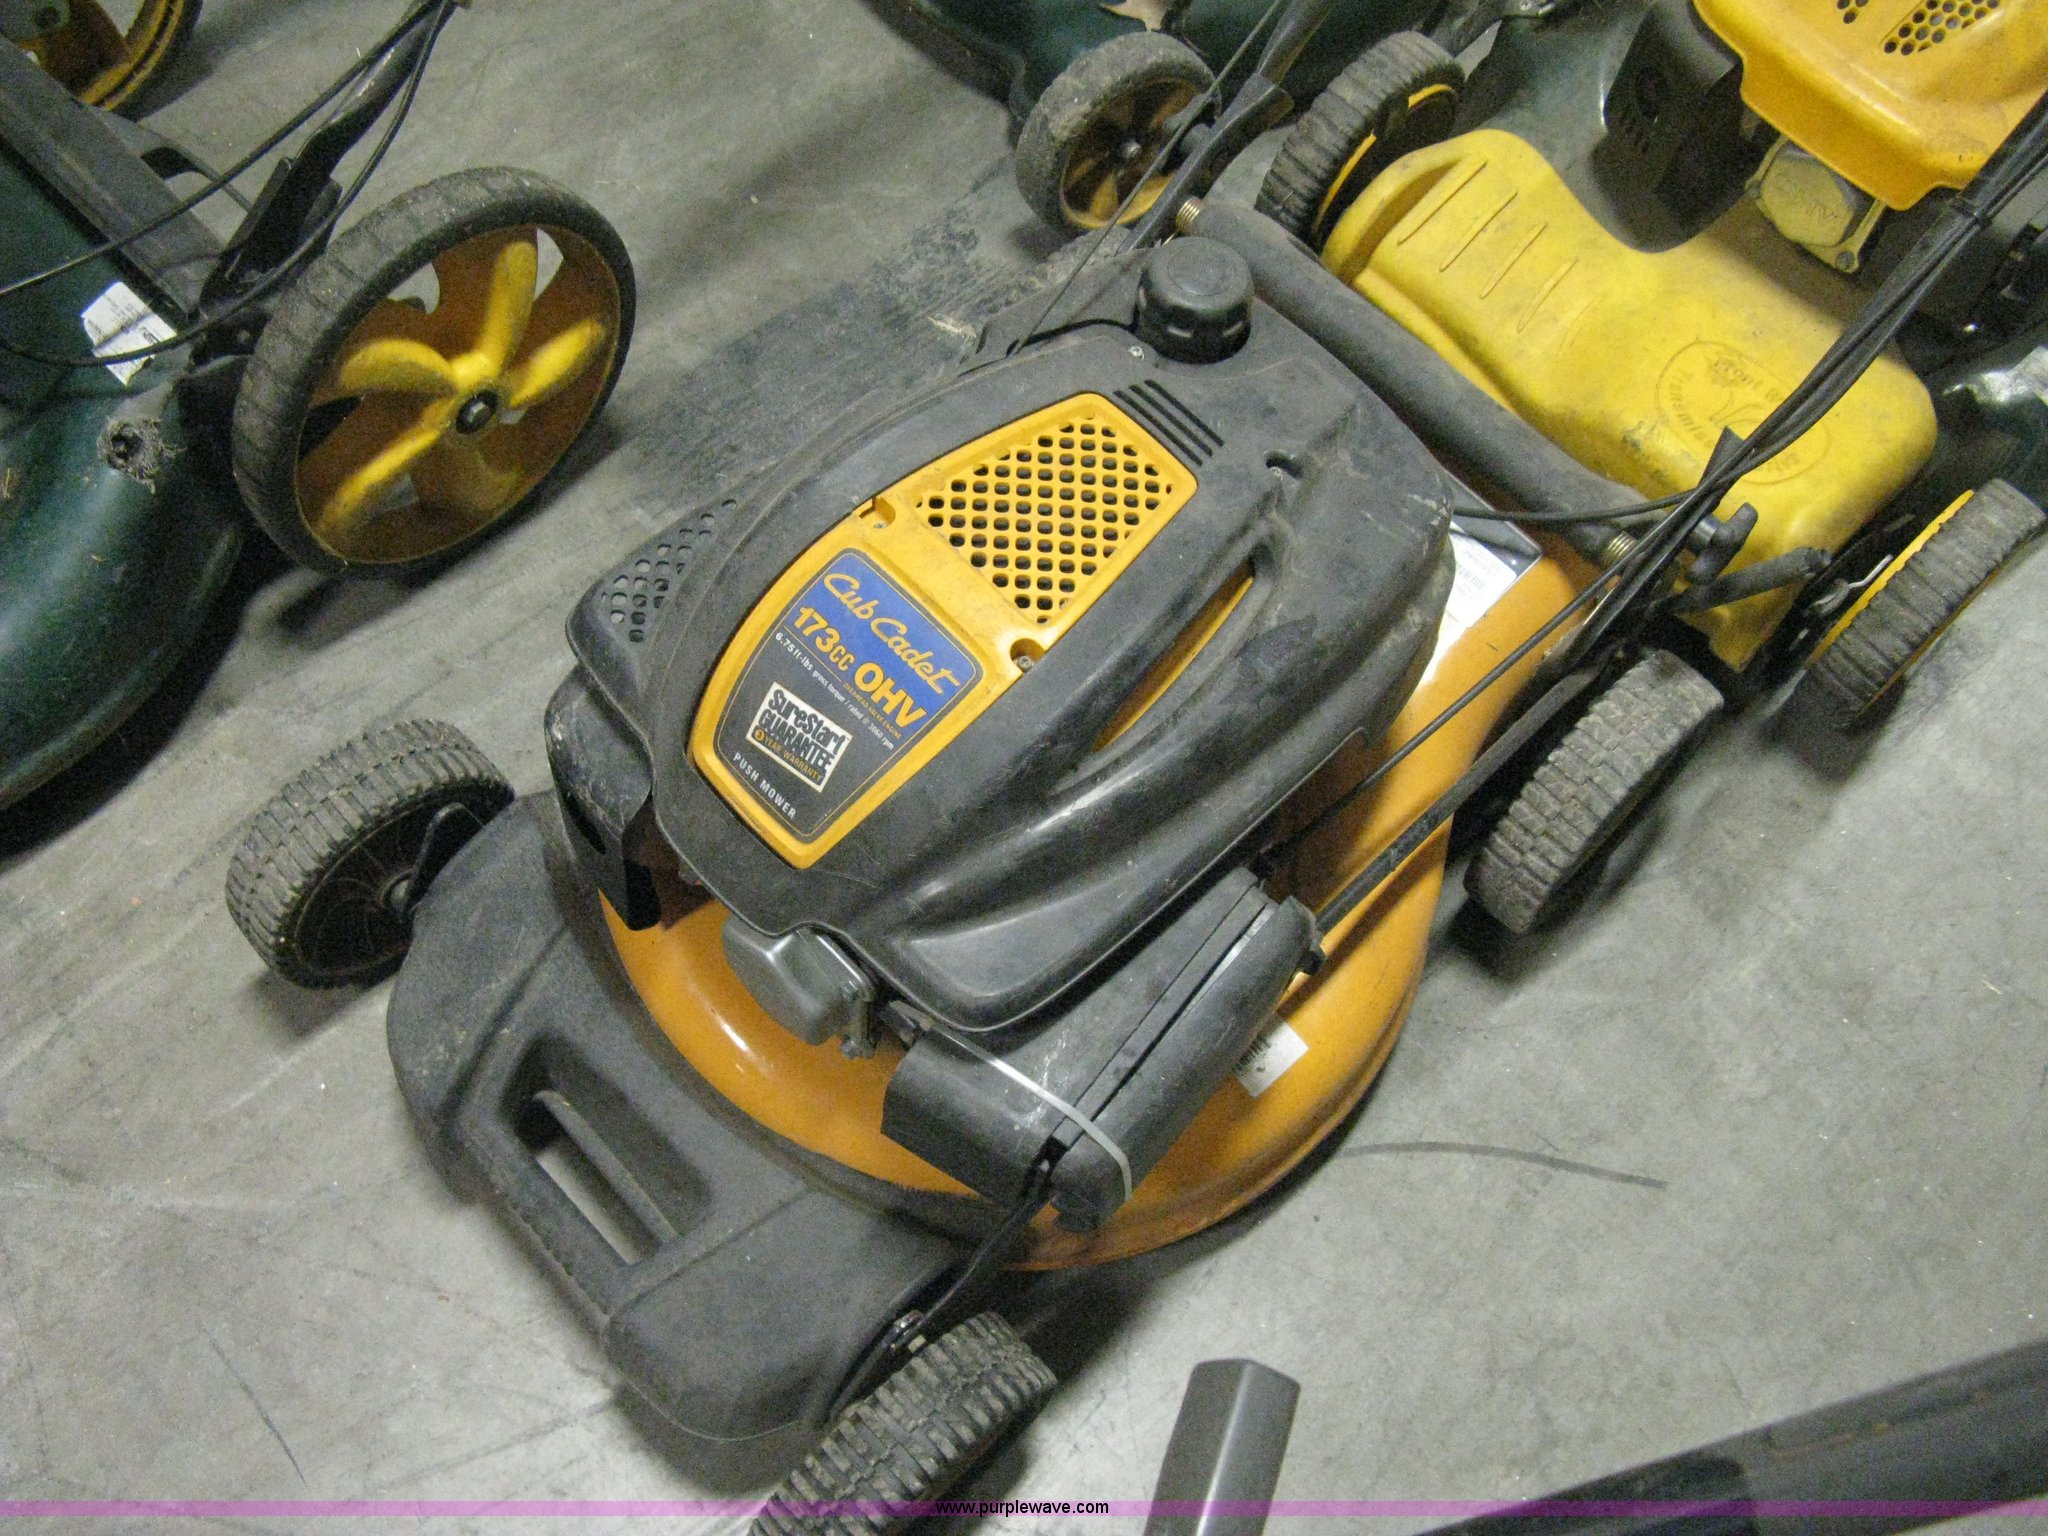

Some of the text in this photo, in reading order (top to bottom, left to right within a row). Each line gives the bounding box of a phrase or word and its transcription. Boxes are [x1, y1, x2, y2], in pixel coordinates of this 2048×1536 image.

[794, 607, 928, 728] 173cc OHV
[824, 573, 961, 695] Cub Cadet
[758, 708, 835, 772] GUARANTEE
[811, 670, 829, 687] gross
[827, 683, 846, 702] torque
[848, 704, 864, 720] rated
[881, 737, 895, 750] rpm
[733, 752, 797, 819] PUSH MOWER
[763, 736, 781, 754] YEAR
[783, 750, 822, 782] WARRANTY
